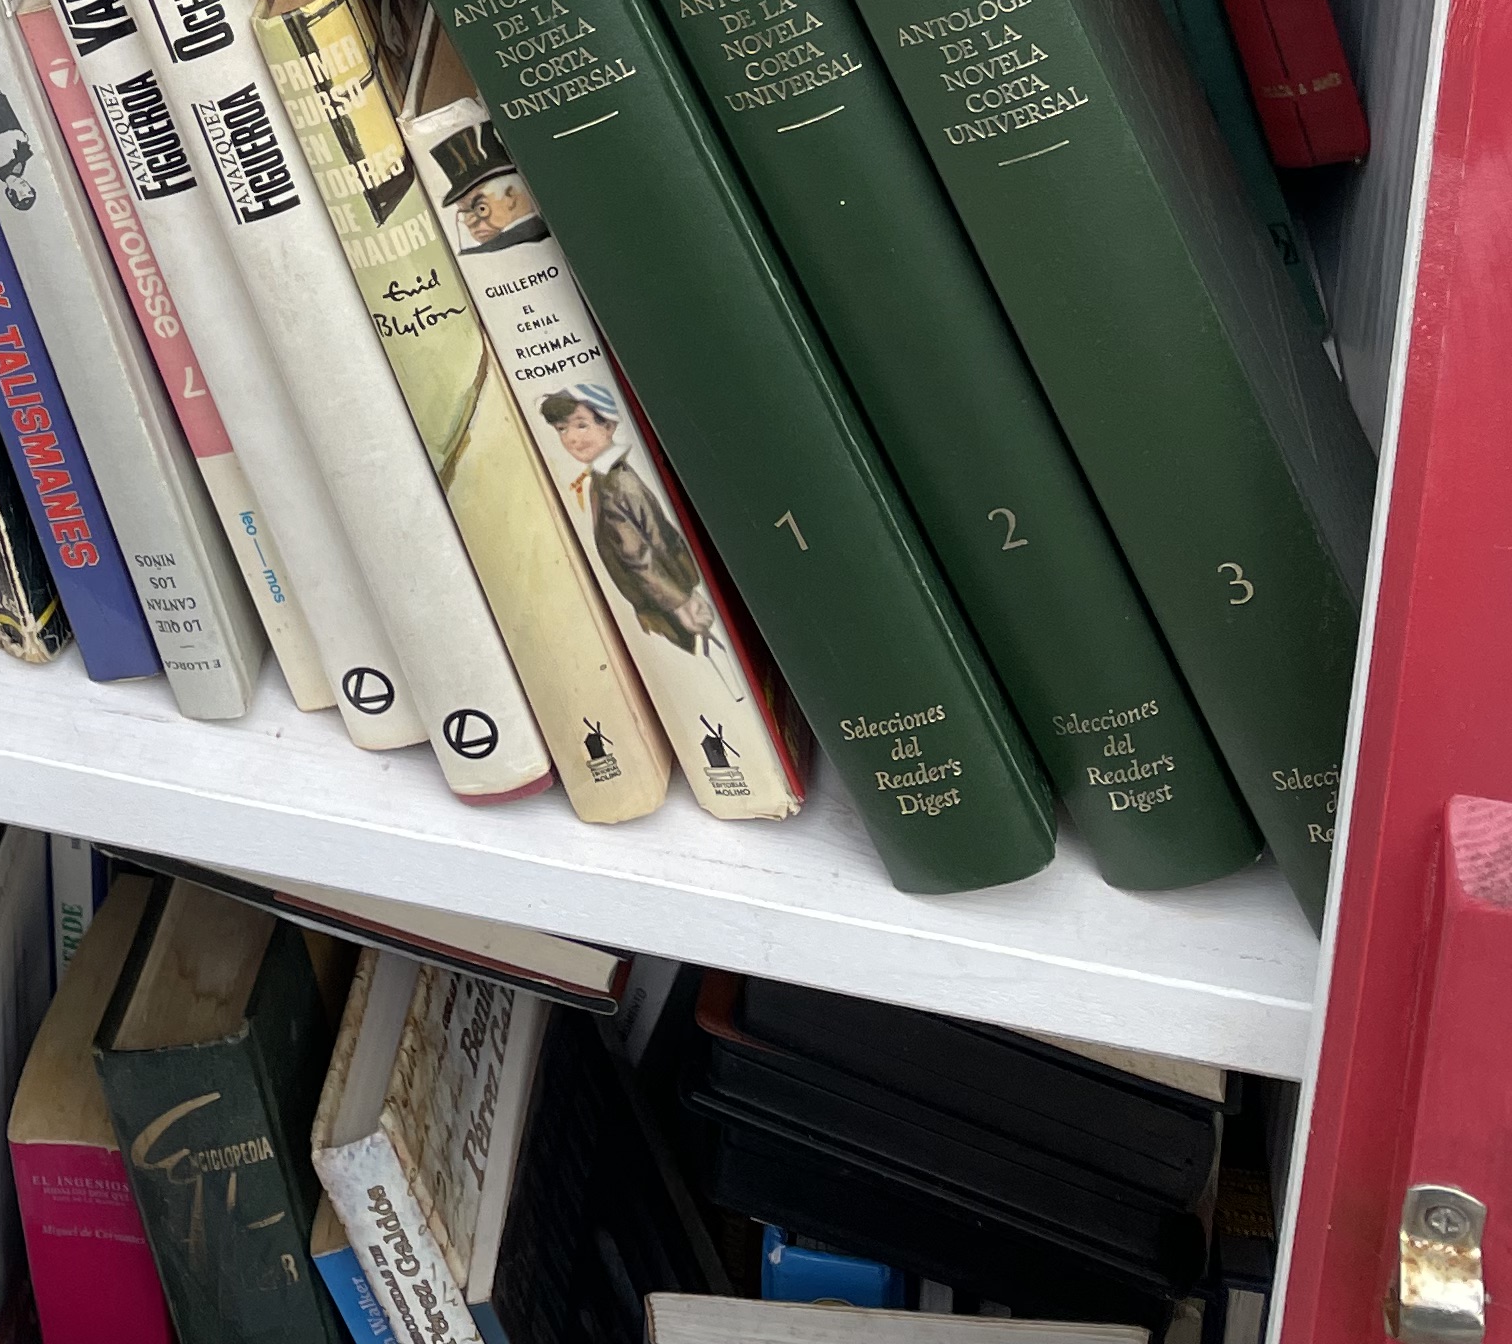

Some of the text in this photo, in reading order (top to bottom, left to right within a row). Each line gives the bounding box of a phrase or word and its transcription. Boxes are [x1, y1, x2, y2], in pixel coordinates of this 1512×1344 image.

[493, 14, 530, 43] DE
[495, 16, 597, 69] NOVELA
[272, 35, 363, 95] PRIMER
[518, 46, 600, 90] CORTA
[282, 78, 367, 131] CURSO
[502, 58, 637, 122] UNIVERSAL
[119, 68, 198, 201] FIGUEROA
[218, 82, 301, 223] FIGUEROA
[306, 134, 333, 165] EN
[315, 143, 406, 199] TORRES
[330, 202, 361, 234] DE
[346, 210, 437, 270] MALORY
[382, 269, 441, 304] Enid
[484, 264, 560, 301] GUILLERMO
[375, 302, 467, 339] Blyton
[516, 312, 561, 334] GENIAL
[514, 344, 602, 383] CROMPTON
[515, 331, 582, 361] RICHMAL
[987, 507, 1029, 551] 2
[135, 553, 176, 570] NIÑOS
[150, 577, 176, 589] LOS
[1216, 561, 1255, 606] 3
[147, 597, 196, 610] CANTAN
[156, 620, 202, 633] LO QUE
[839, 702, 947, 742] Selecciones
[890, 735, 924, 761] del
[875, 755, 963, 792] Reader's
[896, 787, 962, 817] Digest
[352, 1276, 387, 1337] Walker
